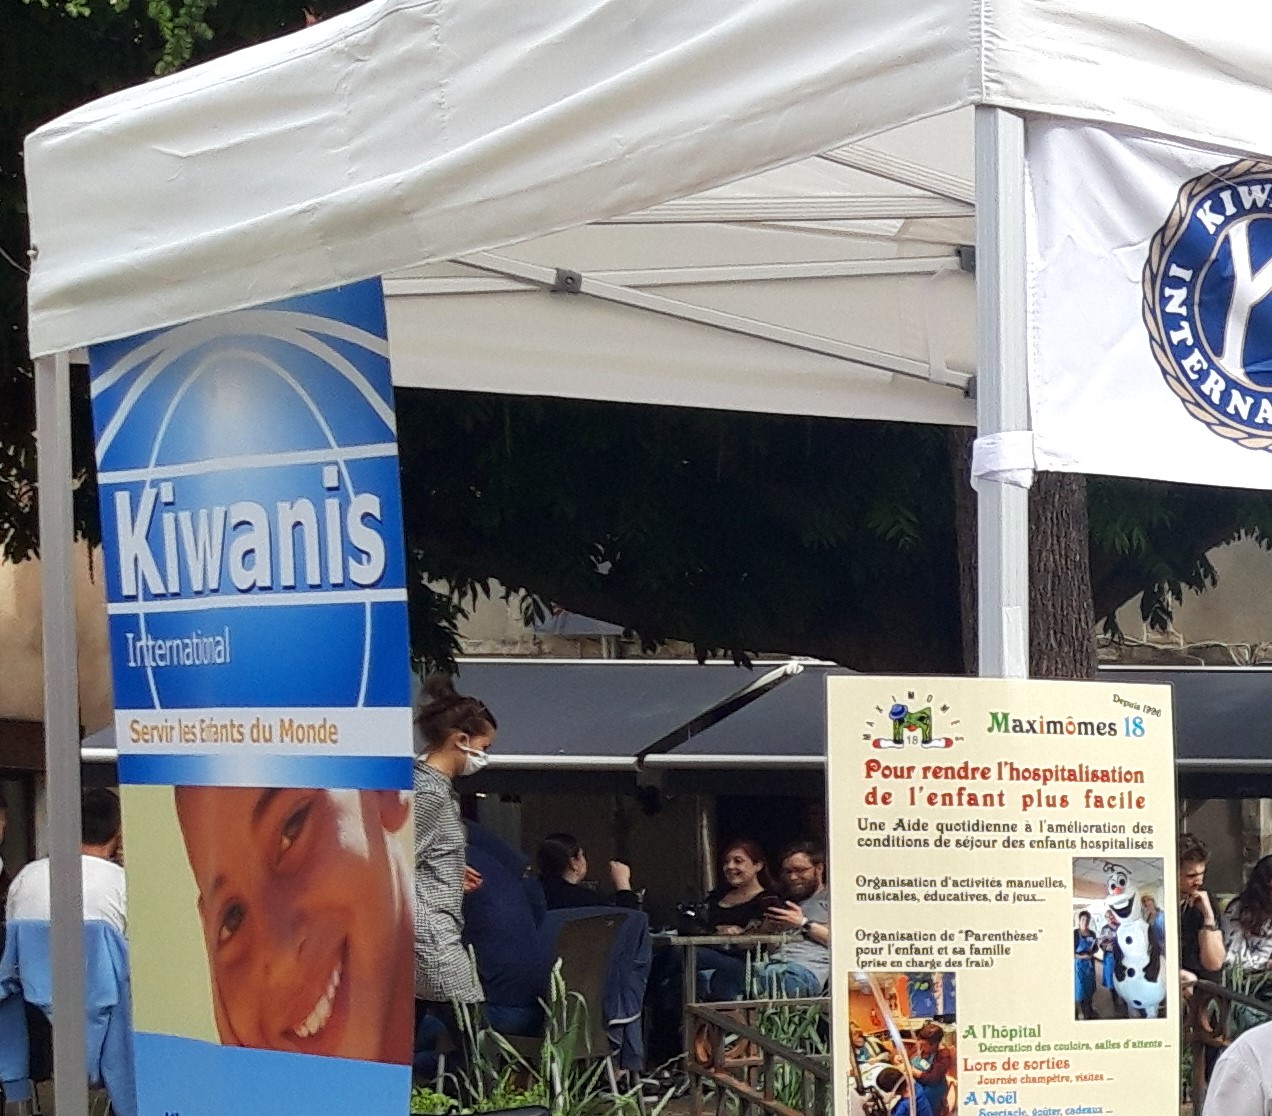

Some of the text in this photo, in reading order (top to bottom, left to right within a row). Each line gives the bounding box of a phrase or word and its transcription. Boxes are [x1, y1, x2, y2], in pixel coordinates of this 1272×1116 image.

[115, 465, 387, 598] Kiwanis
[130, 718, 175, 744] Servir
[178, 718, 197, 743] les
[250, 717, 272, 743] du
[279, 718, 338, 744] Monde
[986, 711, 1146, 738] Maximômes 18
[907, 735, 919, 745] 18
[864, 758, 1145, 786] Pour rendre l'hospitalisation
[864, 786, 1146, 811] de l'enfant plus facile
[857, 817, 1154, 834] Une Aide quotidienne à l'amélioration des
[857, 834, 1154, 852] conditions de séjour des enfants hospitalisés
[855, 874, 1067, 890] Organisation d'activités manuelles,
[856, 890, 920, 903] musicales,
[924, 889, 992, 903] éducatives,
[995, 890, 1009, 902] de
[855, 929, 937, 944] Organisation
[940, 929, 955, 942] de
[855, 943, 1011, 957] pour l'enfant et sa famille
[856, 957, 994, 970] (prise en charge des frais)
[962, 1023, 1042, 1041] A l'hôpital
[978, 1042, 1033, 1053] Décoration
[1034, 1042, 1051, 1052] des
[1054, 1041, 1092, 1051] couloirs,
[1095, 1039, 1121, 1050] salles
[962, 1056, 1071, 1072] Lors de sorties
[977, 1074, 1017, 1086] Journée
[963, 1090, 1017, 1106] A Noël
